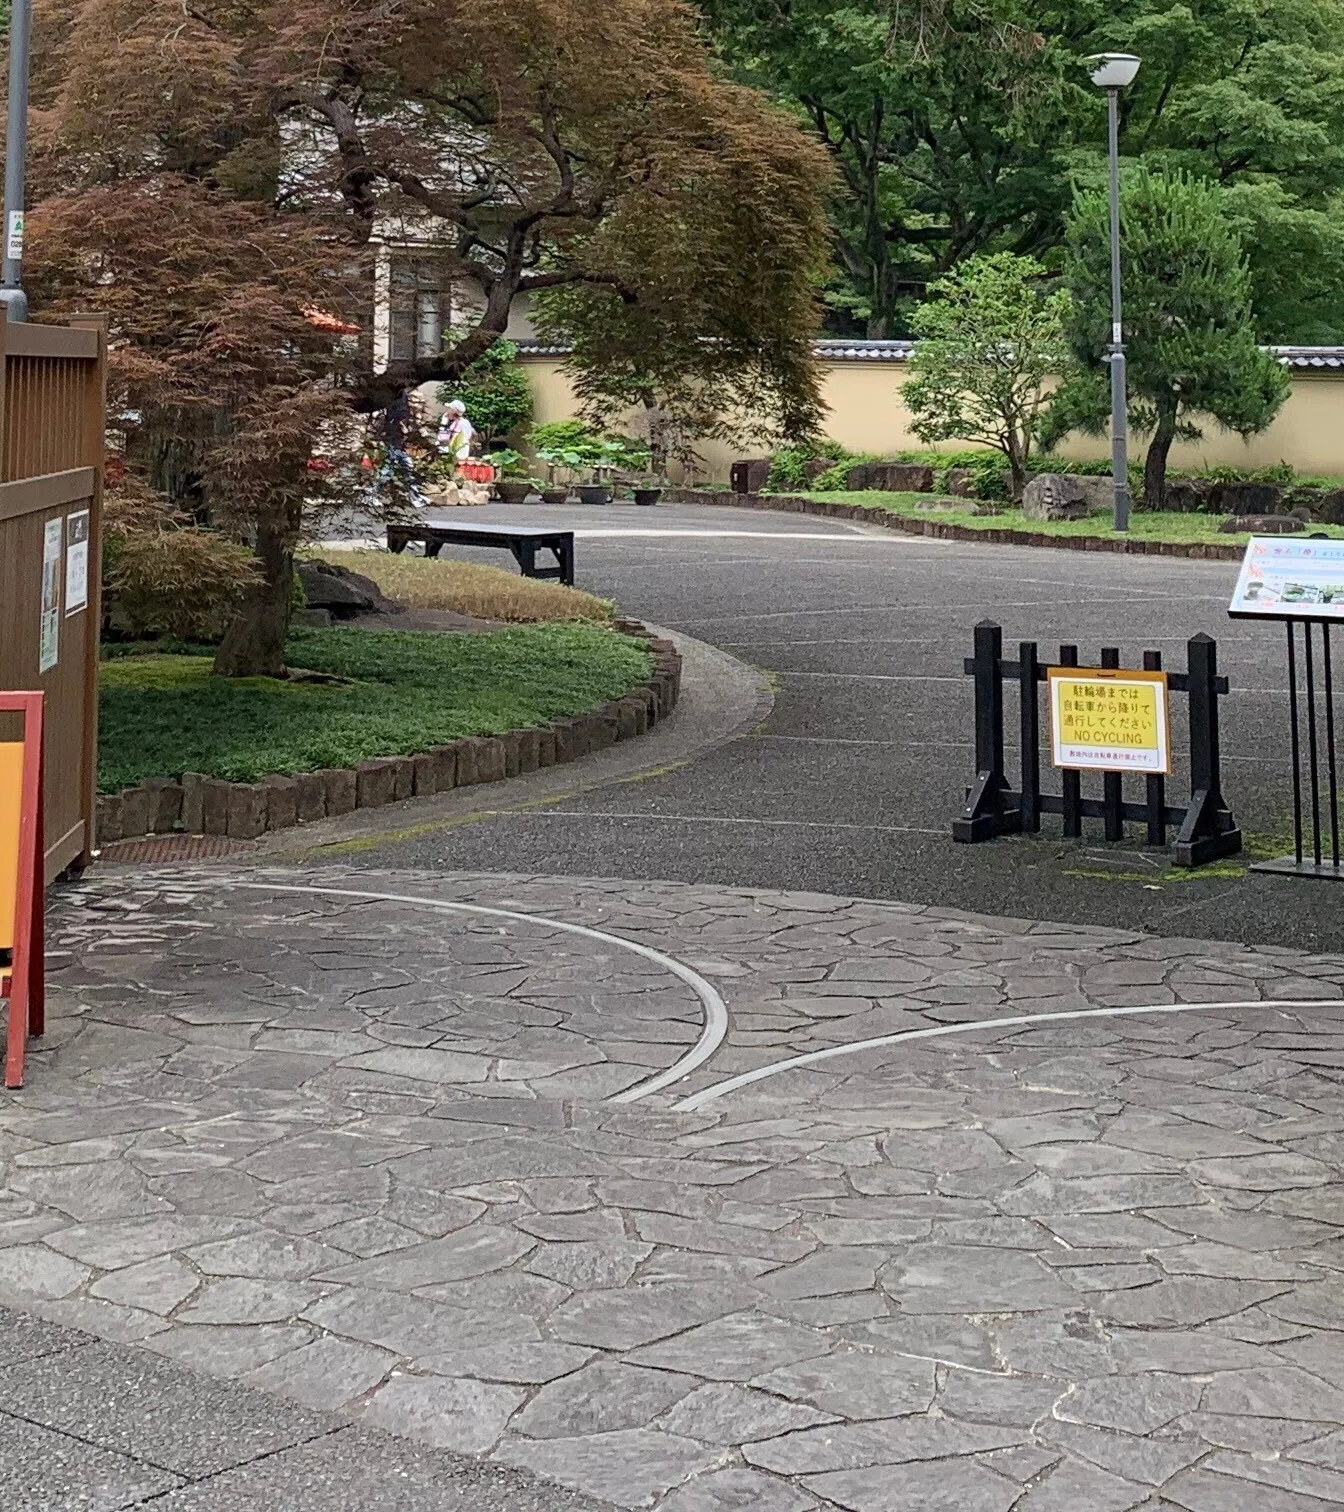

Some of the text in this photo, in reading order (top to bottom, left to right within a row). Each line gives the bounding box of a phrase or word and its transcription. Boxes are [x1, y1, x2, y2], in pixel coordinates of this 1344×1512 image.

[1073, 685, 1139, 699] 駐輪場までは
[1063, 700, 1150, 715] 自転車から降りて
[1063, 714, 1152, 730] 通行してください
[1074, 730, 1143, 744] NO CYCLING
